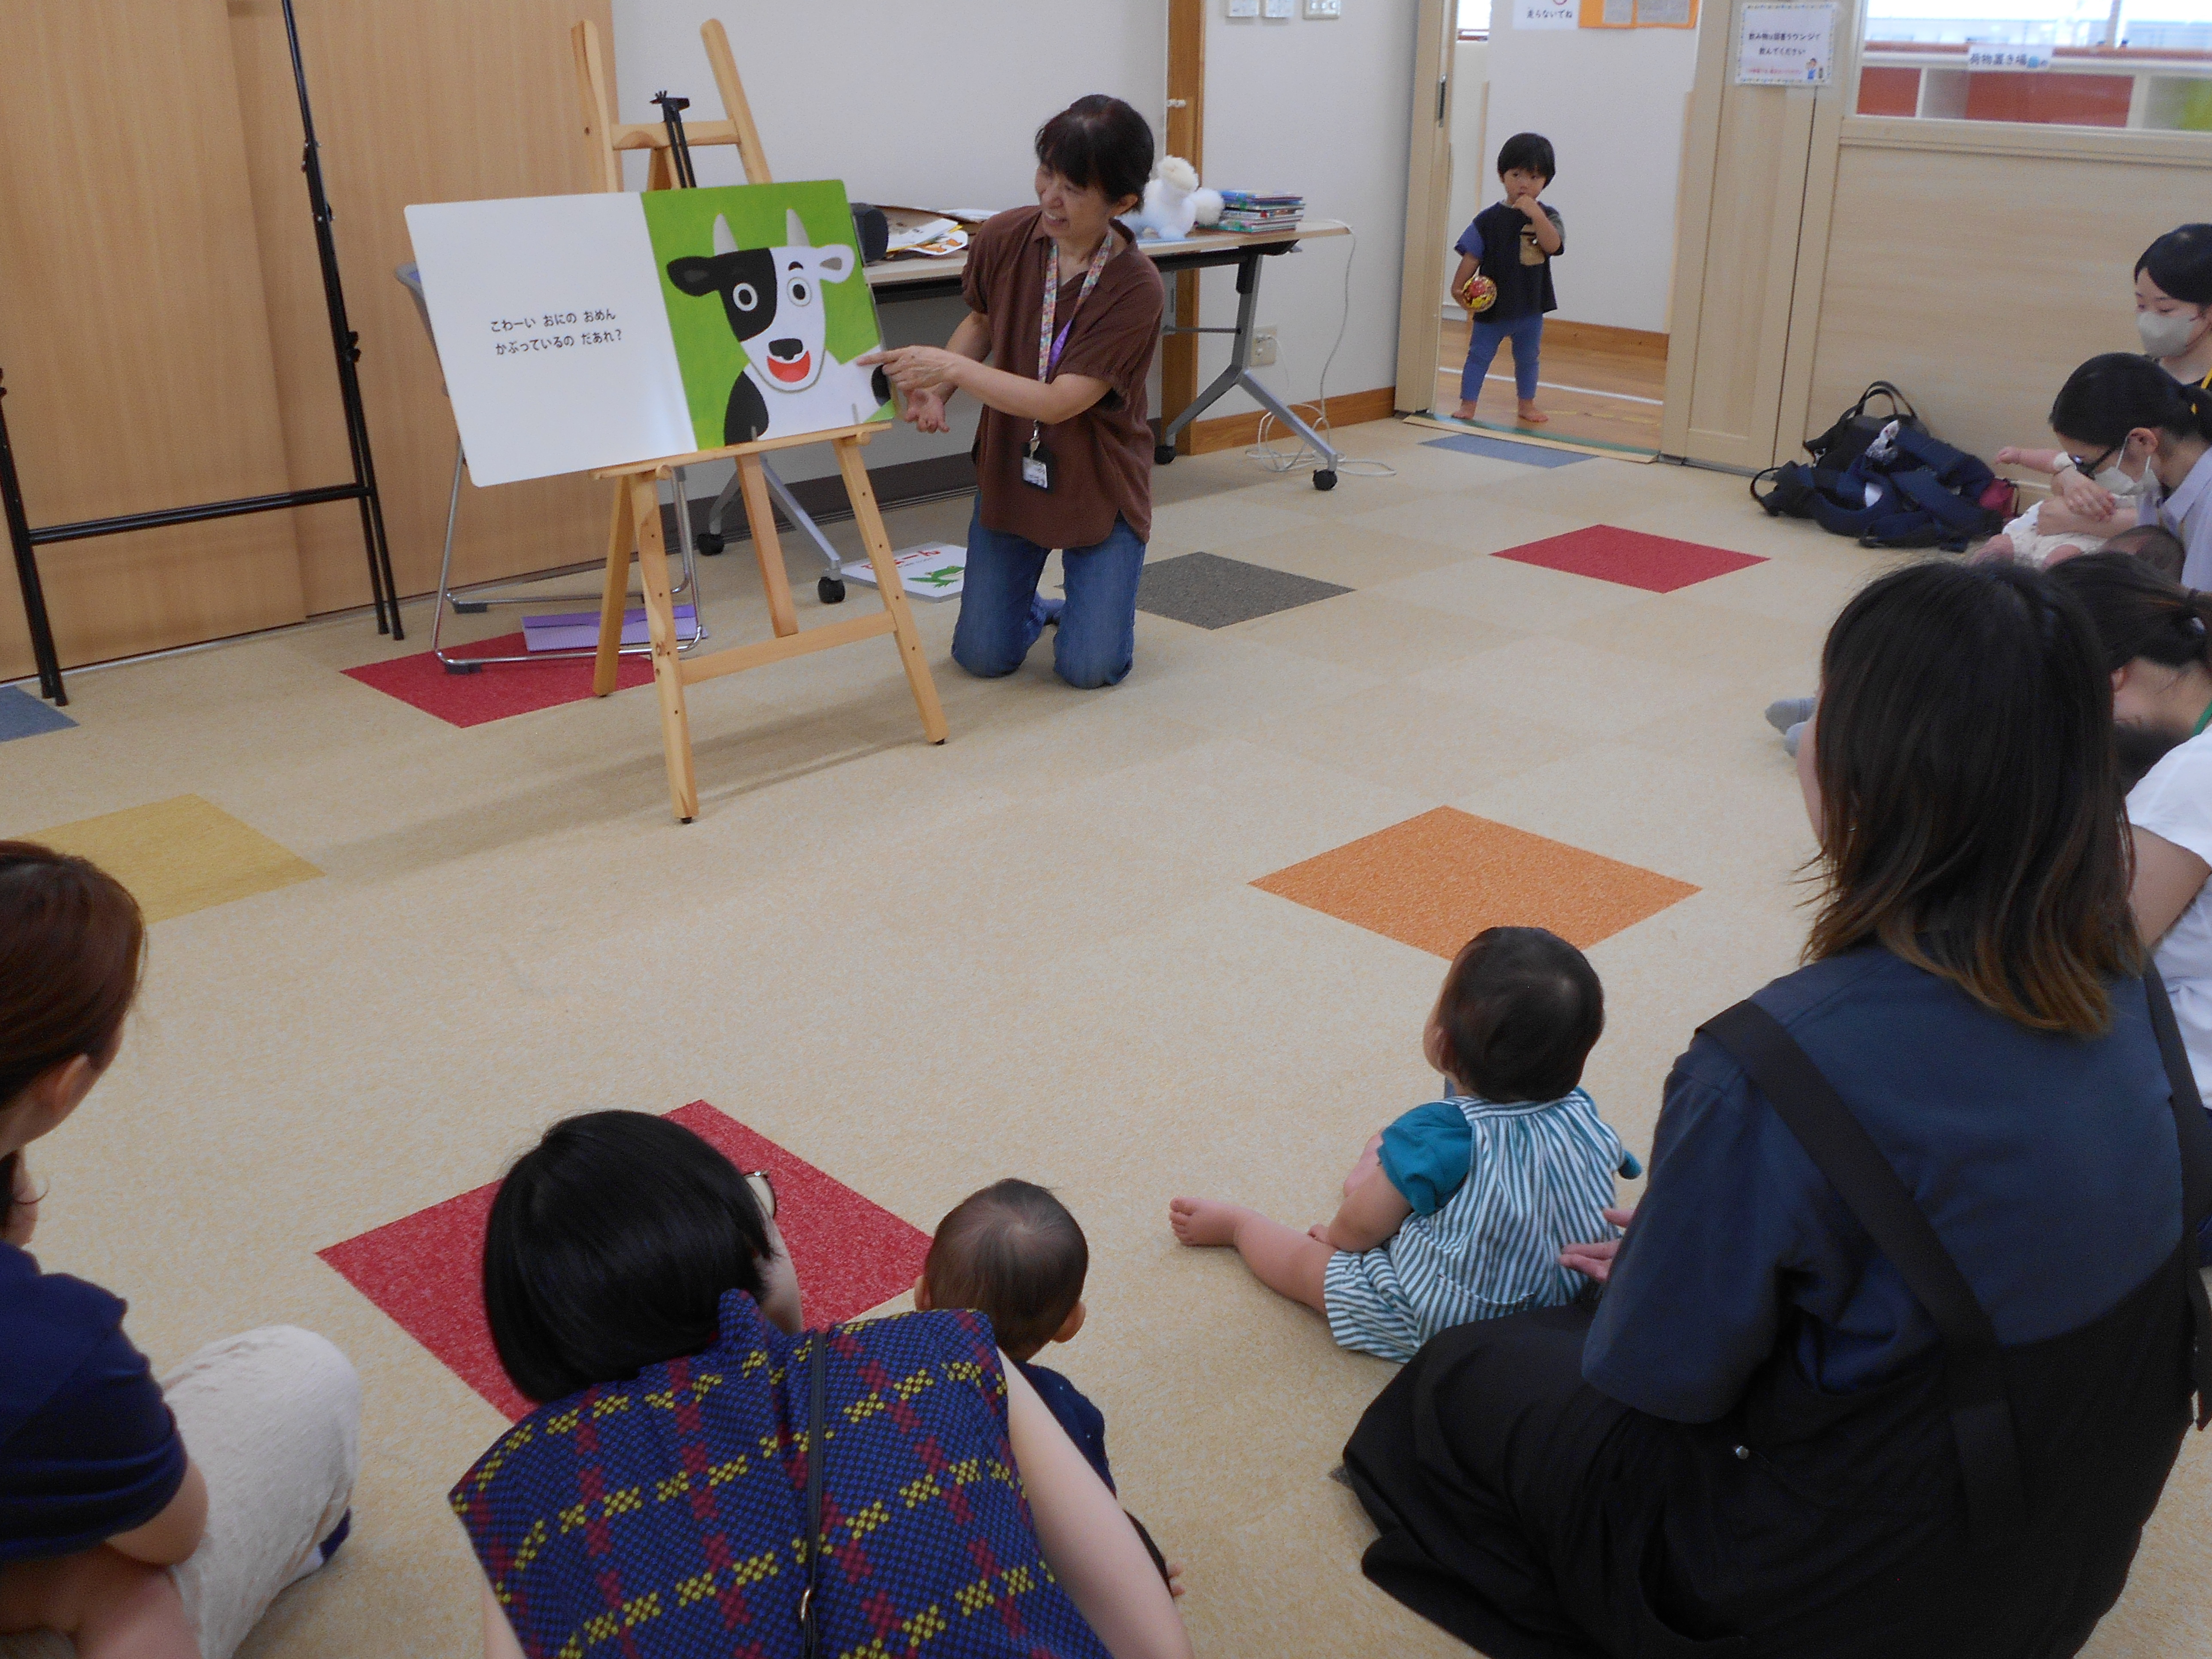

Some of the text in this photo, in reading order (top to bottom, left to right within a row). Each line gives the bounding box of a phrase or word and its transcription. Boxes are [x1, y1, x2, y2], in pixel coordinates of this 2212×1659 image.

[1526, 9, 1572, 18] 走らないでね
[490, 309, 616, 332] こわーい おにの おめん
[495, 329, 621, 355] かぶっているの だあれ？
